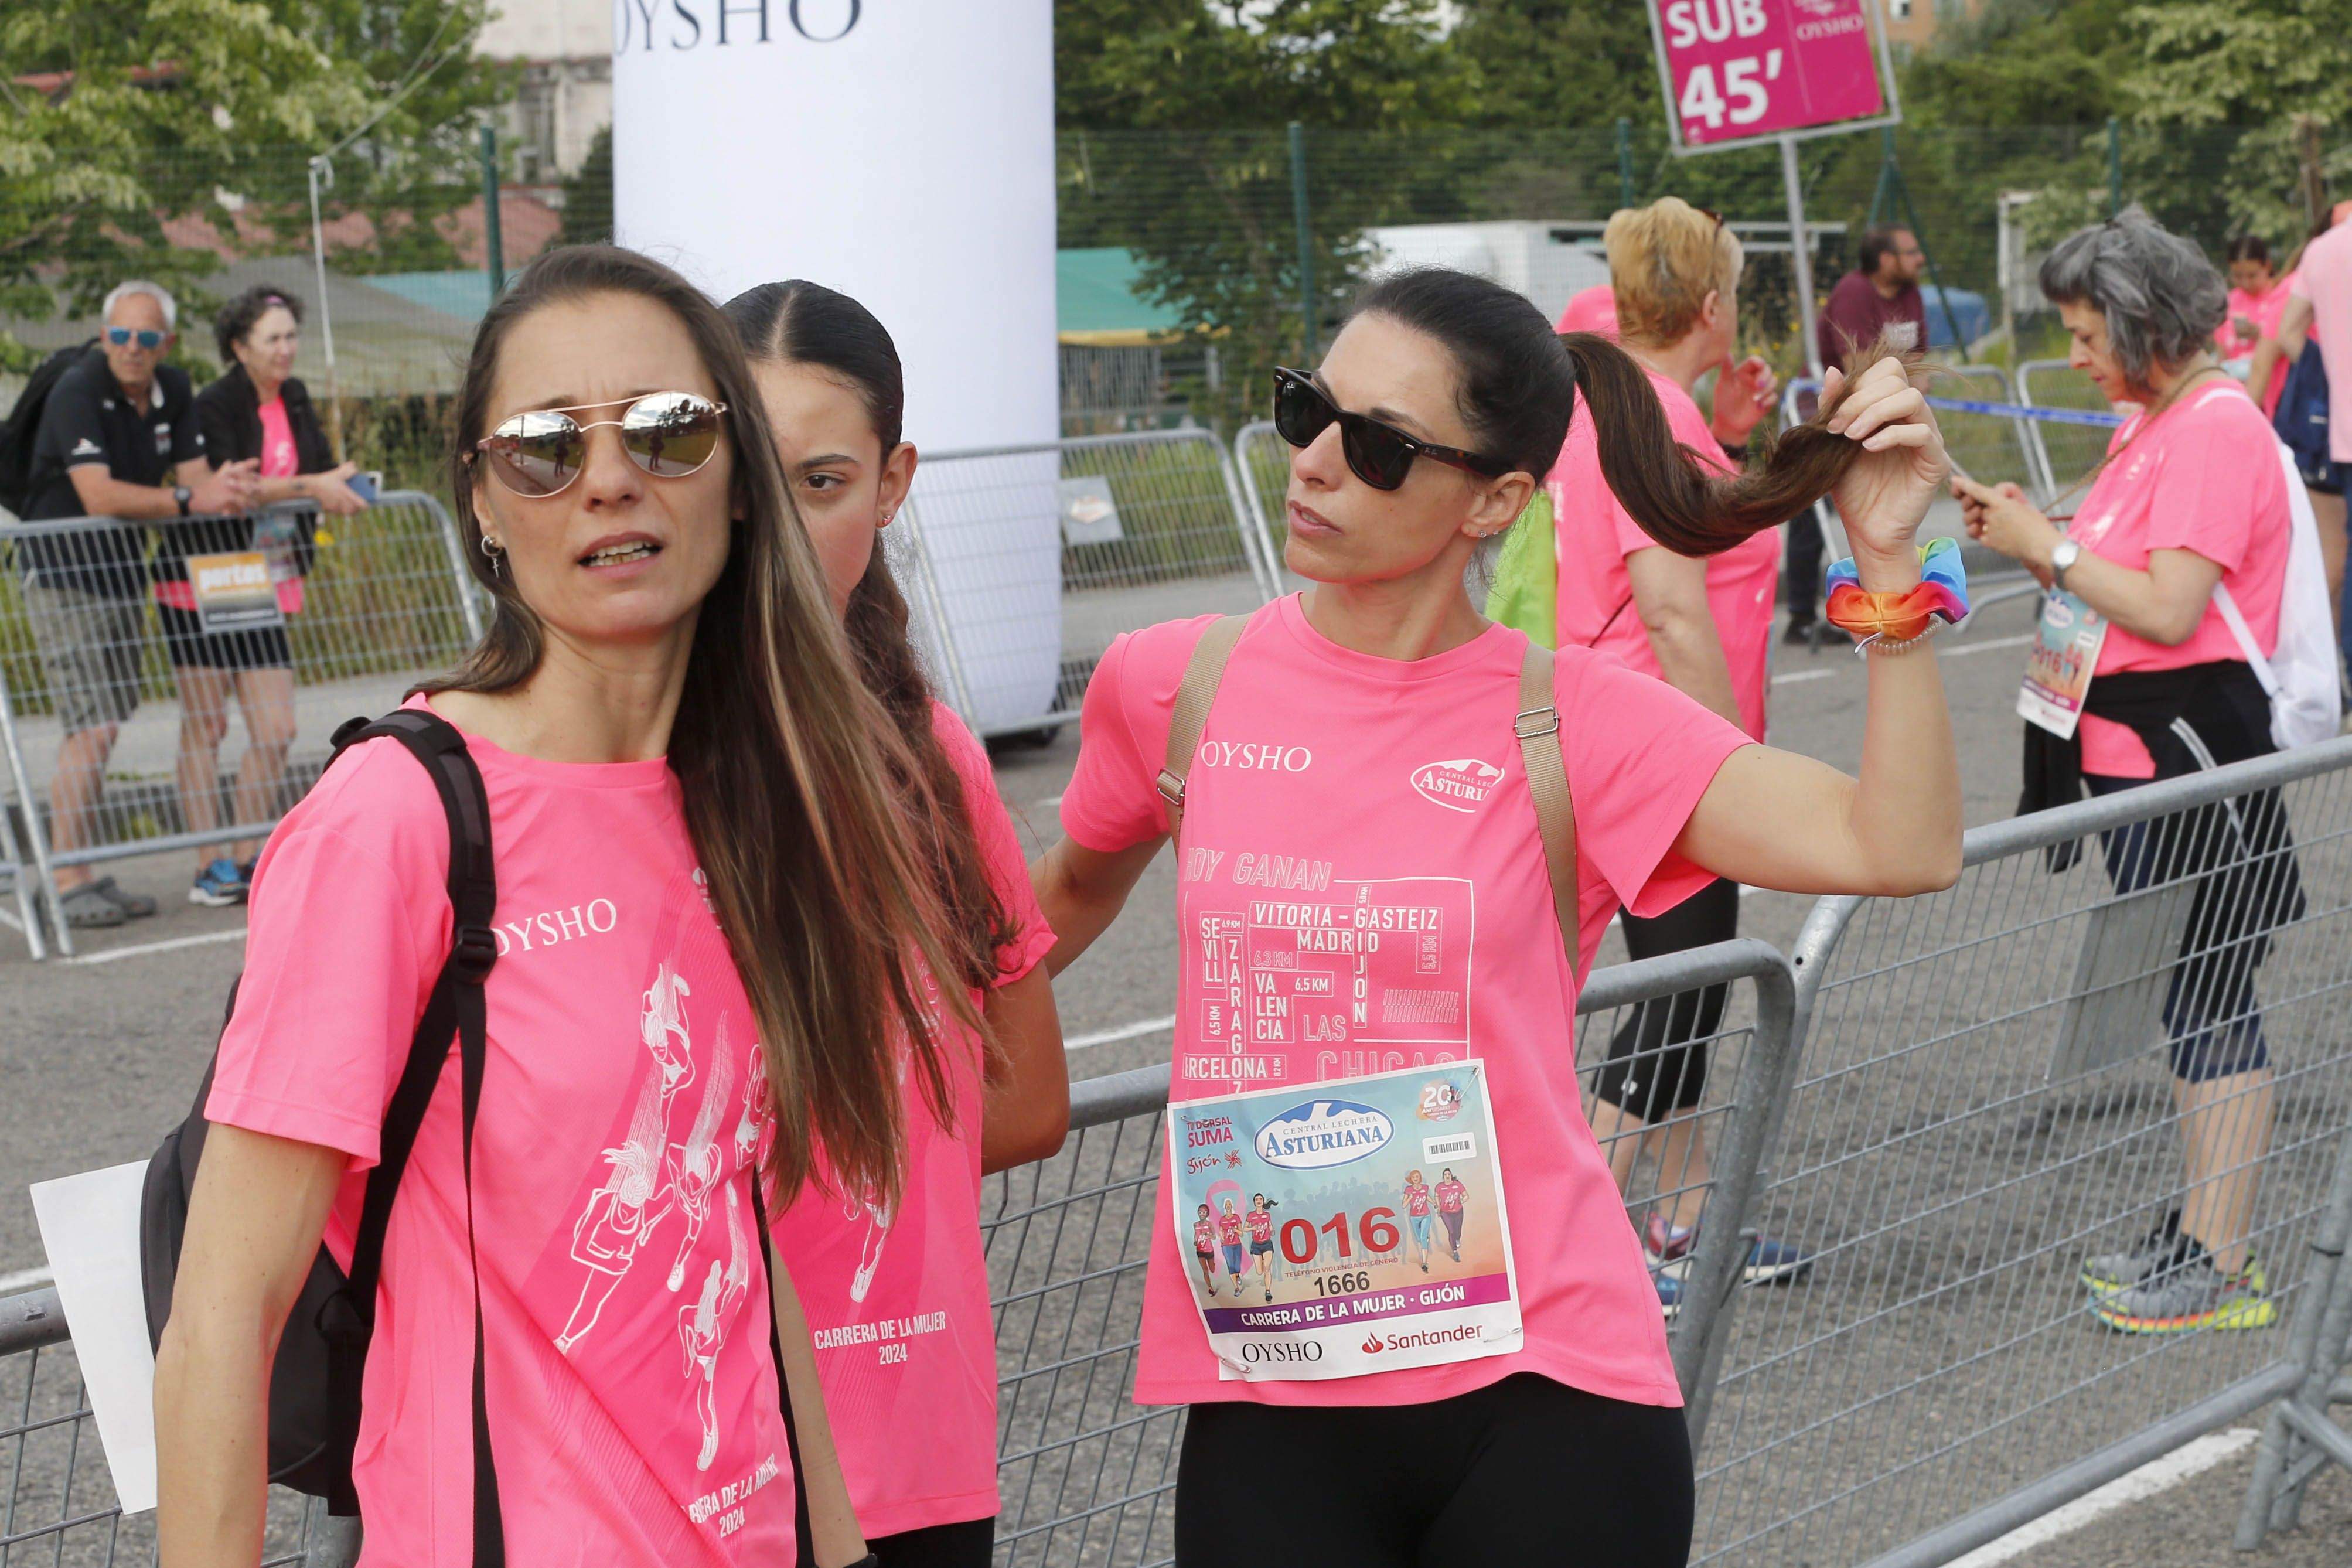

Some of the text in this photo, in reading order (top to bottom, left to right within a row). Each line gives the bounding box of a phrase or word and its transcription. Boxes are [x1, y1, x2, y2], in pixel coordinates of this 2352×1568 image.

[1666, 0, 1767, 49] SUB
[1796, 13, 1864, 41] OYSHO
[1200, 741, 1311, 772] OYSHO
[1440, 771, 1475, 783] CENTRAL
[1232, 853, 1332, 891] GANAN
[1255, 903, 1332, 926] VITORIA
[1355, 908, 1438, 930] GASTEIZ
[1297, 929, 1379, 953] MADRID
[1422, 935, 1437, 952] KM
[1273, 952, 1293, 967] KM
[1255, 973, 1276, 994] VA
[1312, 977, 1329, 991] KM
[1209, 1005, 1221, 1021] KM
[1256, 996, 1287, 1018] LEN
[1256, 1019, 1284, 1041] CIA
[1303, 1015, 1347, 1042] LAS
[1188, 1127, 1234, 1148] SUMA
[1283, 1115, 1378, 1136] CENTRAL LECHERA
[1264, 1125, 1385, 1158] ASTURIANA
[1187, 1154, 1221, 1175] gijón
[1279, 1207, 1400, 1265] 016
[1284, 1268, 1321, 1278] TELÉFONO
[1321, 1262, 1358, 1273] VIOLENCIA
[1371, 1257, 1399, 1266] GÉNERO
[1314, 1270, 1370, 1296] 1666
[1241, 1307, 1301, 1327] CARRERA
[1305, 1304, 1326, 1322] DE
[1328, 1300, 1349, 1318] LA
[1353, 1293, 1406, 1315] MUJER
[1419, 1285, 1465, 1307] GIJÓN
[814, 1310, 946, 1350] CARRERA DE LA MUJER
[879, 1342, 908, 1365] 2024
[1242, 1323, 1484, 1364] OYSHO Santander
[721, 1482, 738, 1509] DE
[739, 1475, 753, 1501] LA
[718, 1505, 746, 1538] 2024
